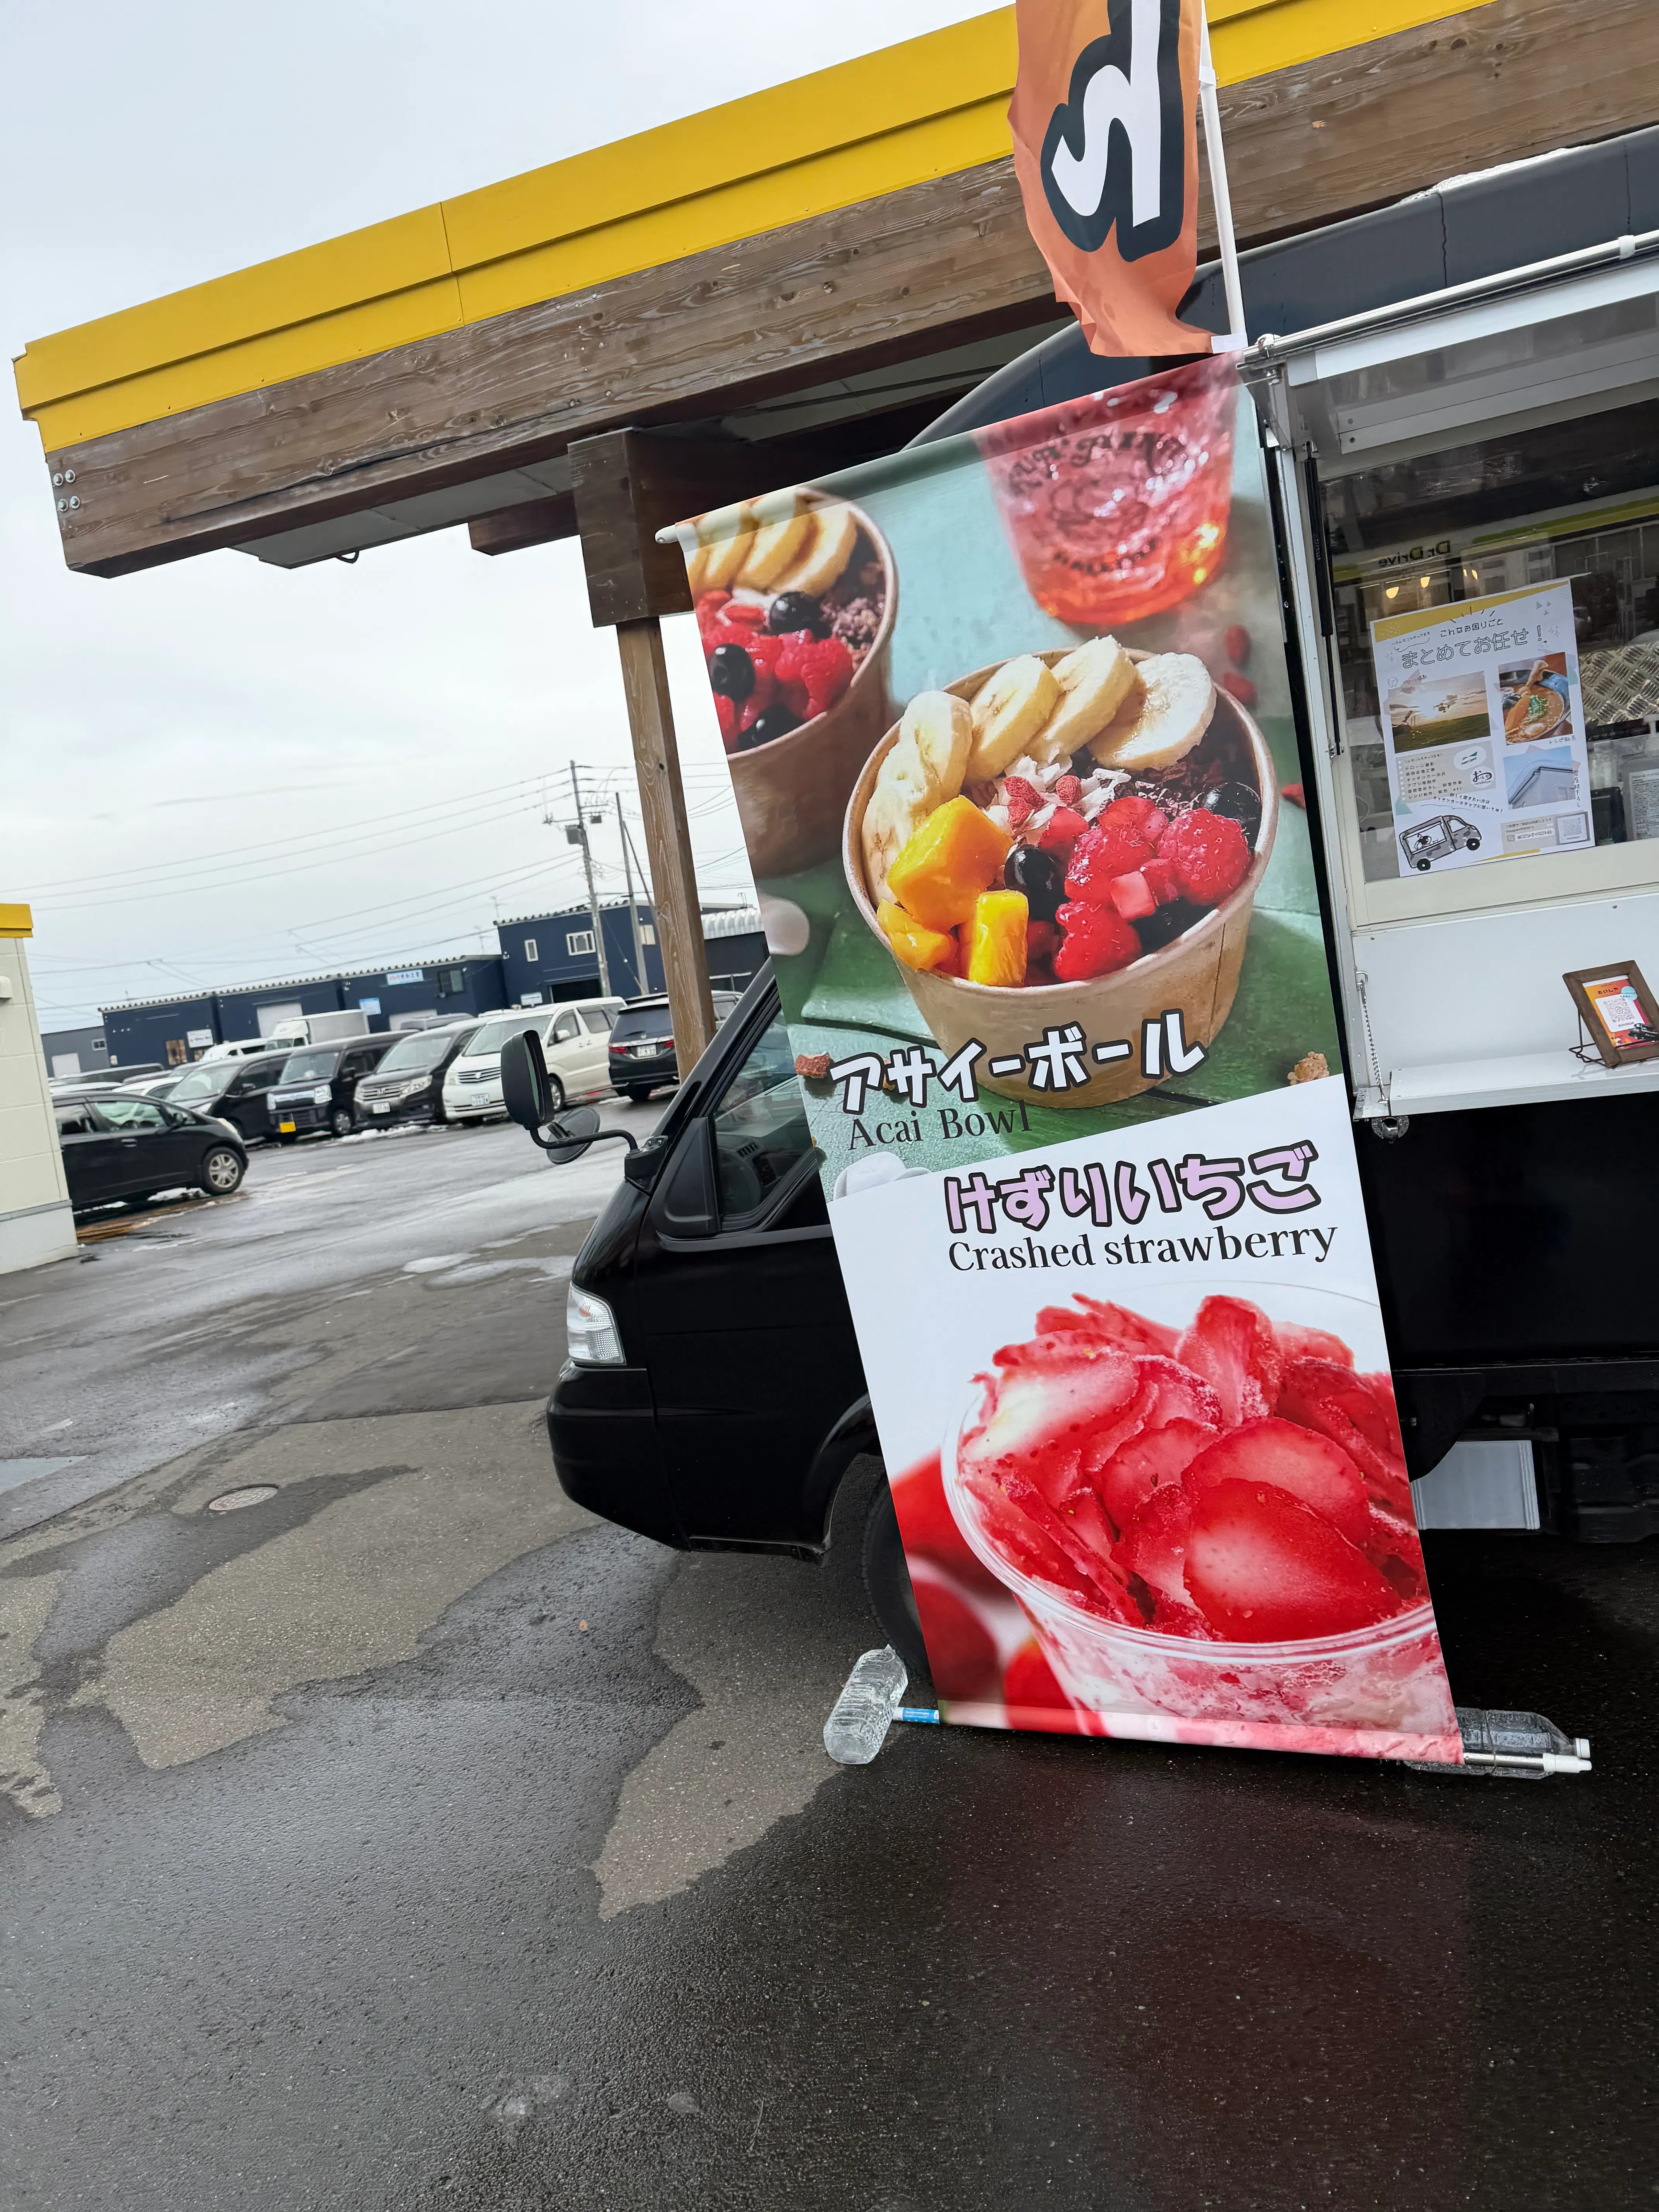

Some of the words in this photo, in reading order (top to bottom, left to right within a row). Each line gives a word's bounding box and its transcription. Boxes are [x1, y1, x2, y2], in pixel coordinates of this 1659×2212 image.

[1440, 619, 1503, 637] こんなお困りごと
[829, 1008, 1207, 1115] アサイーボール
[847, 1112, 924, 1150] Acai
[942, 1101, 1032, 1140] Bowl
[943, 1139, 1321, 1234] けずりいちご
[948, 1234, 1096, 1271] Crashed
[1103, 1226, 1338, 1265] strawberry
